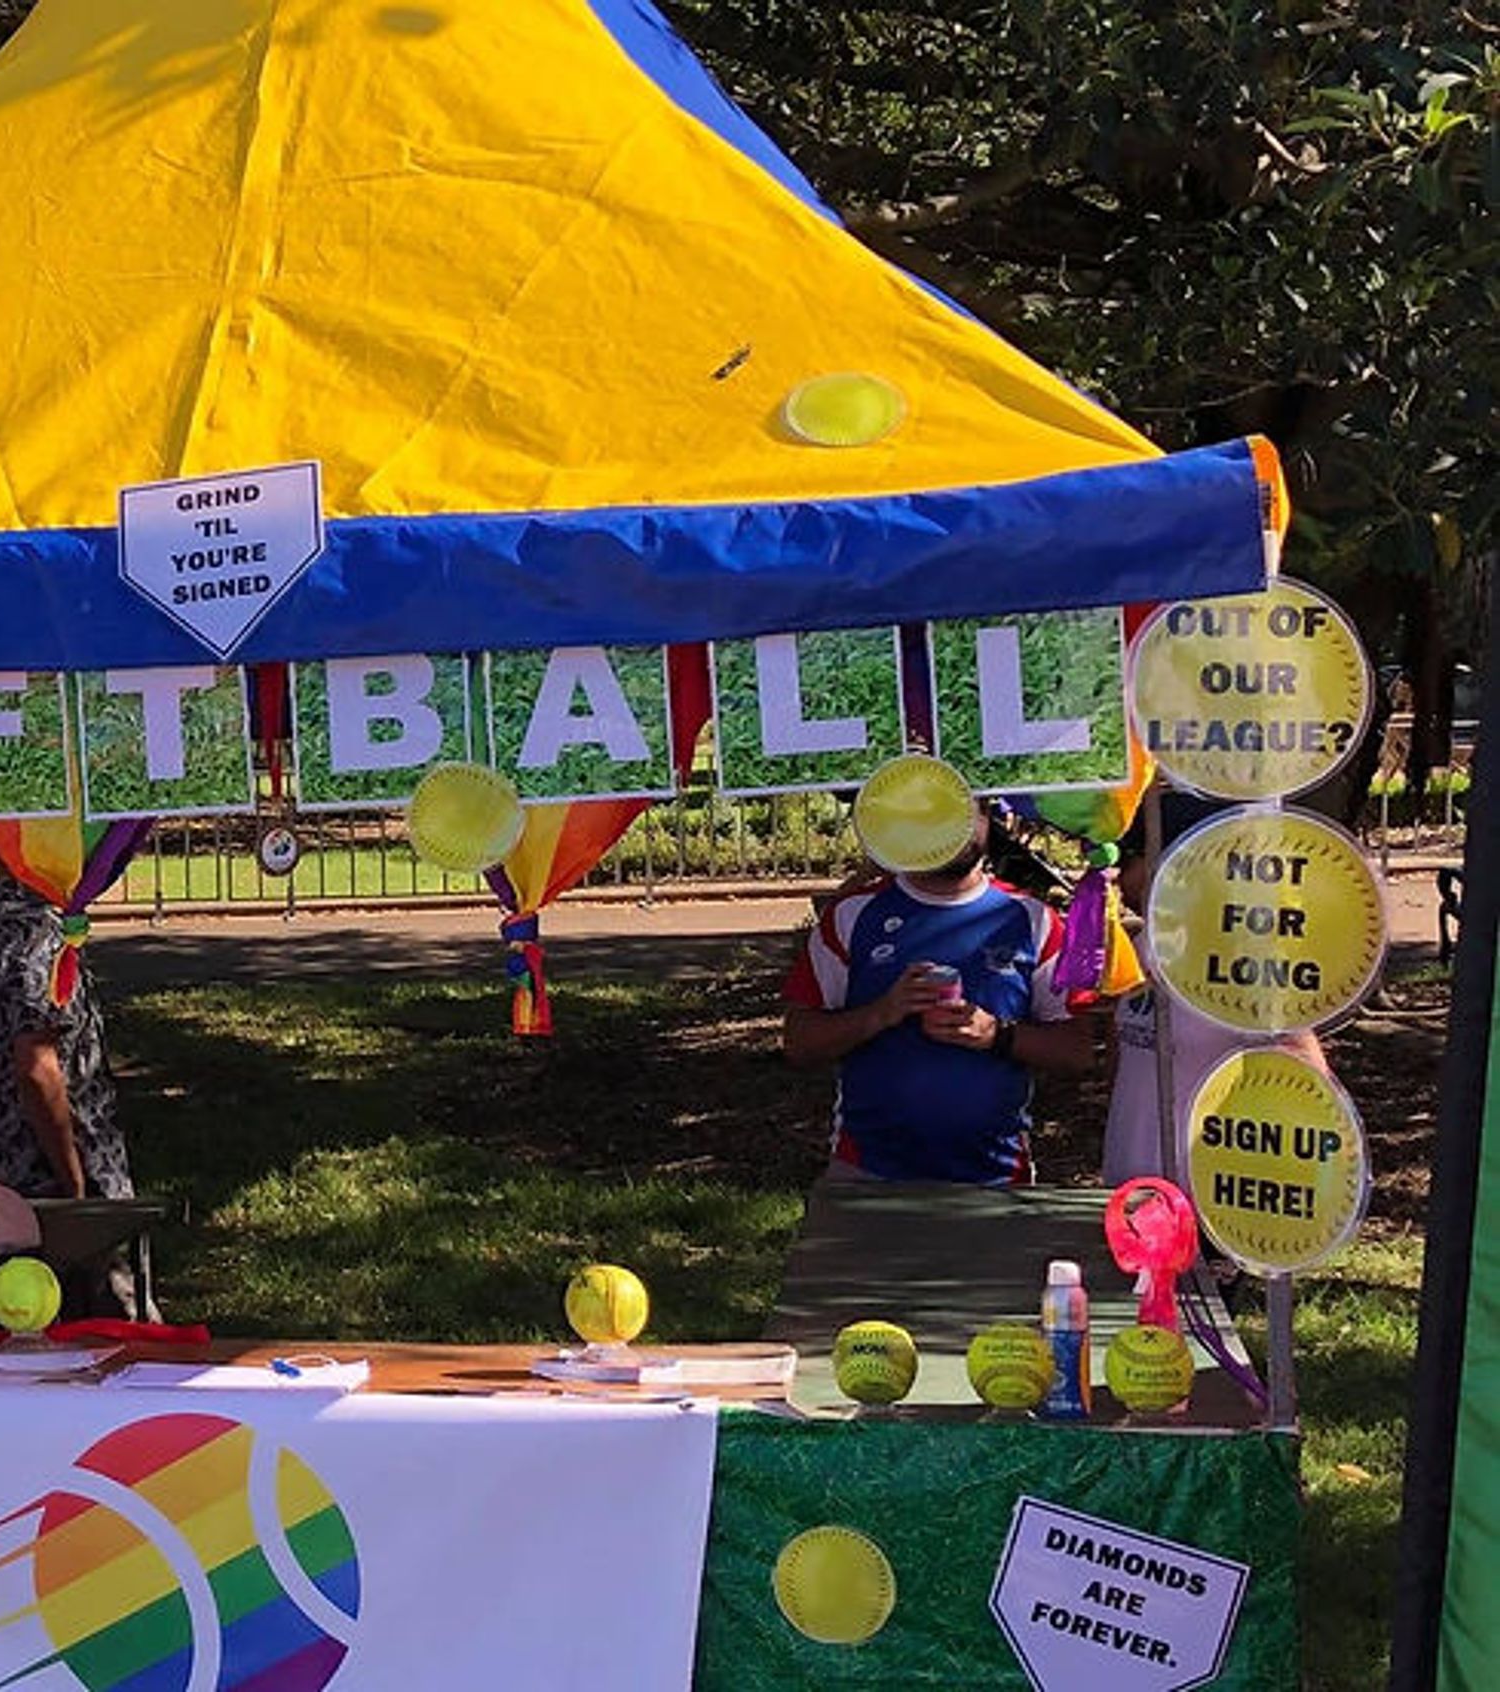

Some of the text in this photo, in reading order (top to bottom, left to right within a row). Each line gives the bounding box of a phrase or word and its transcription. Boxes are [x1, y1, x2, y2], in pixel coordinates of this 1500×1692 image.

[176, 485, 260, 511] GRIND
[194, 517, 239, 538] 'TIL
[170, 542, 267, 574] YOU'RE
[172, 574, 272, 605] SIGNED
[1166, 605, 1329, 638] OUT OF
[1200, 661, 1297, 695] OUR
[1148, 719, 1355, 753] LEAGUE?
[1226, 851, 1309, 885] NOT
[1221, 904, 1306, 938] FOR
[1206, 955, 1321, 992] LONG
[1202, 1115, 1342, 1163] SIGN UP
[1214, 1173, 1316, 1220] HERE!
[1044, 1528, 1208, 1597] DIAMONDS
[1082, 1580, 1147, 1618] ARE
[1030, 1602, 1178, 1669] FOREVER.
